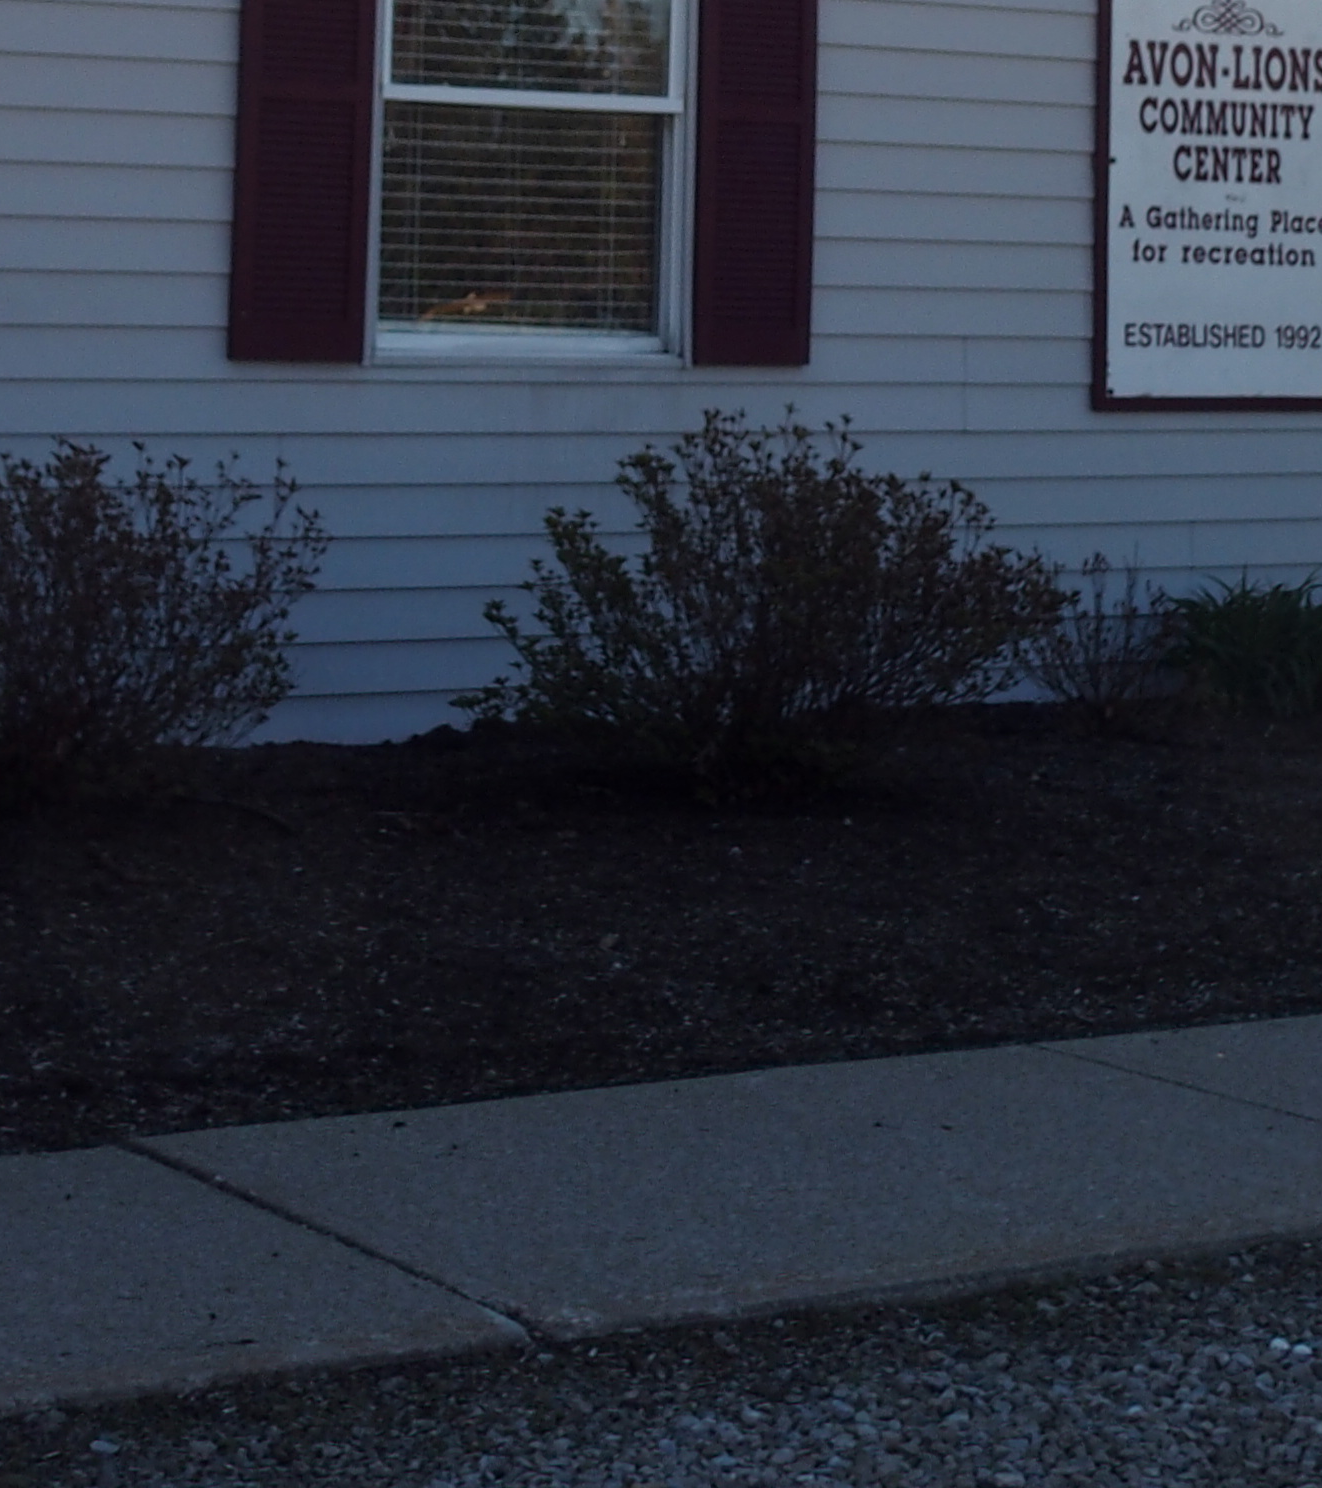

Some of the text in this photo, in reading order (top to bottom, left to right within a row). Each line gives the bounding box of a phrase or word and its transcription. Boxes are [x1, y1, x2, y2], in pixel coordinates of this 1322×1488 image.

[1139, 97, 1314, 139] COMMUNITY
[1173, 145, 1282, 184] CENTER
[1118, 205, 1135, 229] A
[1146, 205, 1259, 239] Gathering
[1132, 238, 1316, 267] for recreation
[1123, 323, 1322, 349] ESTABLISHED 1992
